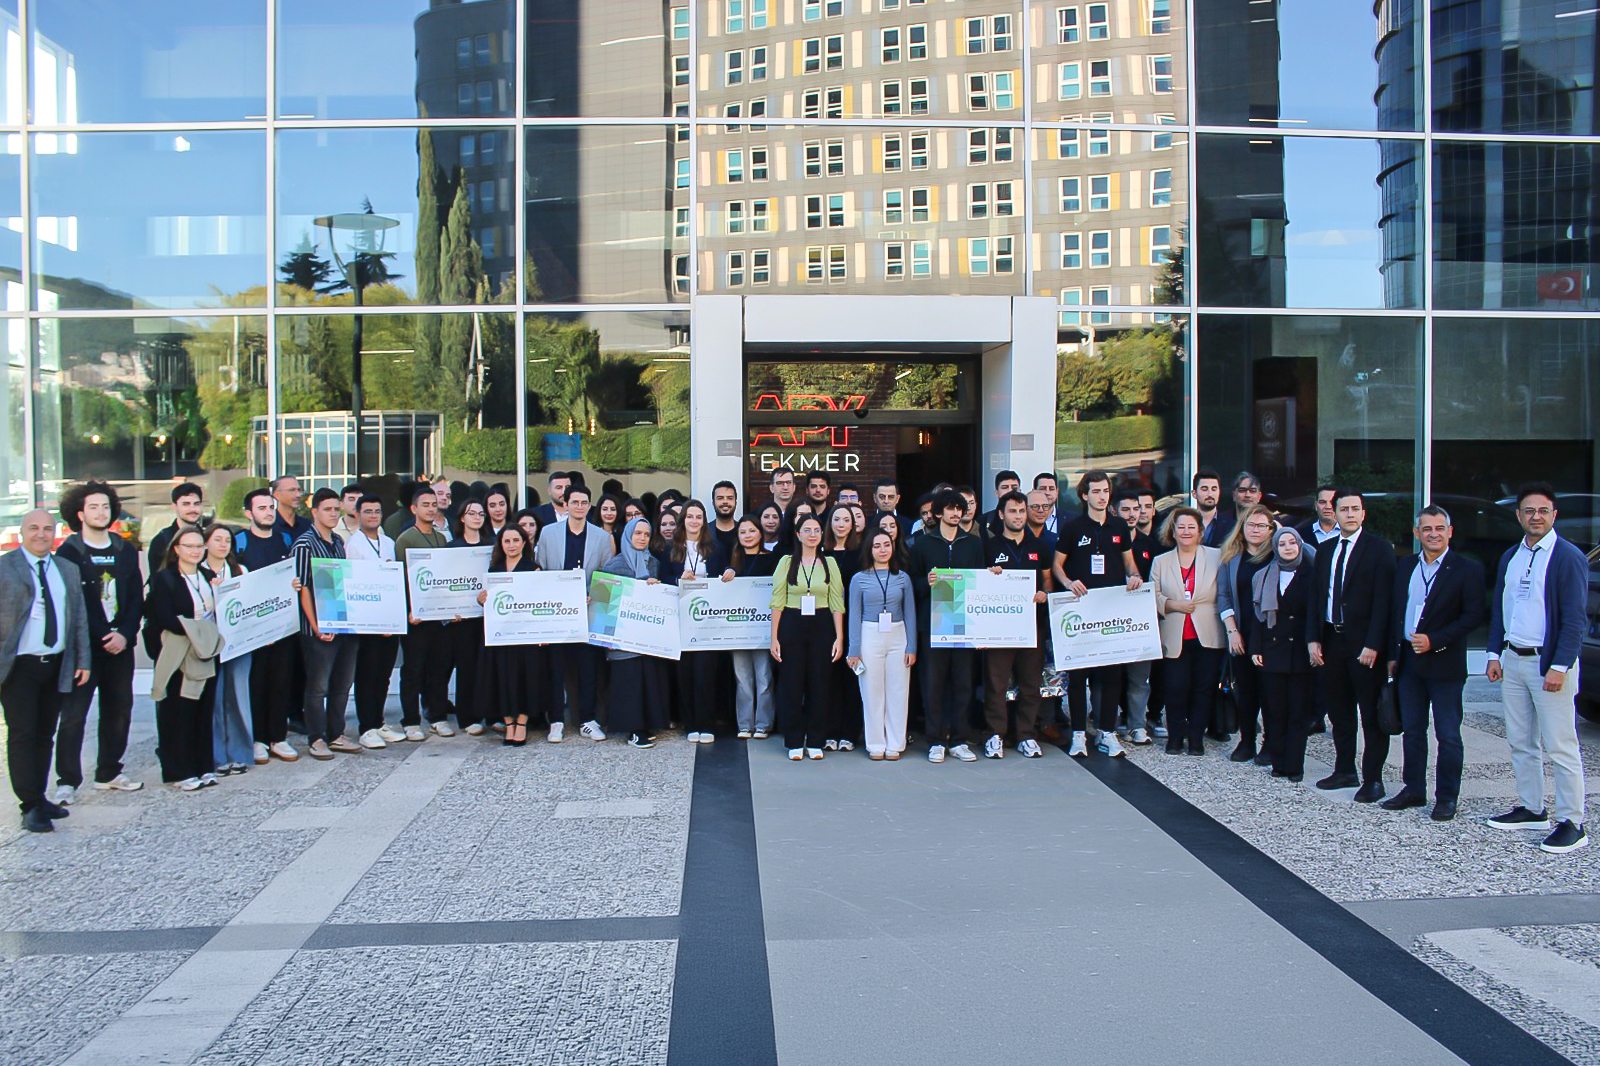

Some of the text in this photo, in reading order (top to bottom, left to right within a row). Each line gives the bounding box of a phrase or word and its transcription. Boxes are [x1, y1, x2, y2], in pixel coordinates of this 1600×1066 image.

[420, 576, 478, 586] Automotive
[471, 582, 483, 590] 20
[346, 583, 398, 591] HACKATHON
[346, 592, 382, 602] İKİNCİSİ
[967, 594, 1028, 602] HACKATHON
[229, 596, 280, 619] Automotive
[274, 598, 292, 612] 2026
[498, 600, 562, 610] Automotive
[966, 604, 1024, 616] ÜÇÜNCÜSÜ
[555, 608, 579, 616] 2026
[693, 606, 757, 616] Automotive
[620, 610, 666, 626] BİRİNCİSİ
[1066, 616, 1133, 631] Automotive
[1125, 622, 1150, 633] 2026
